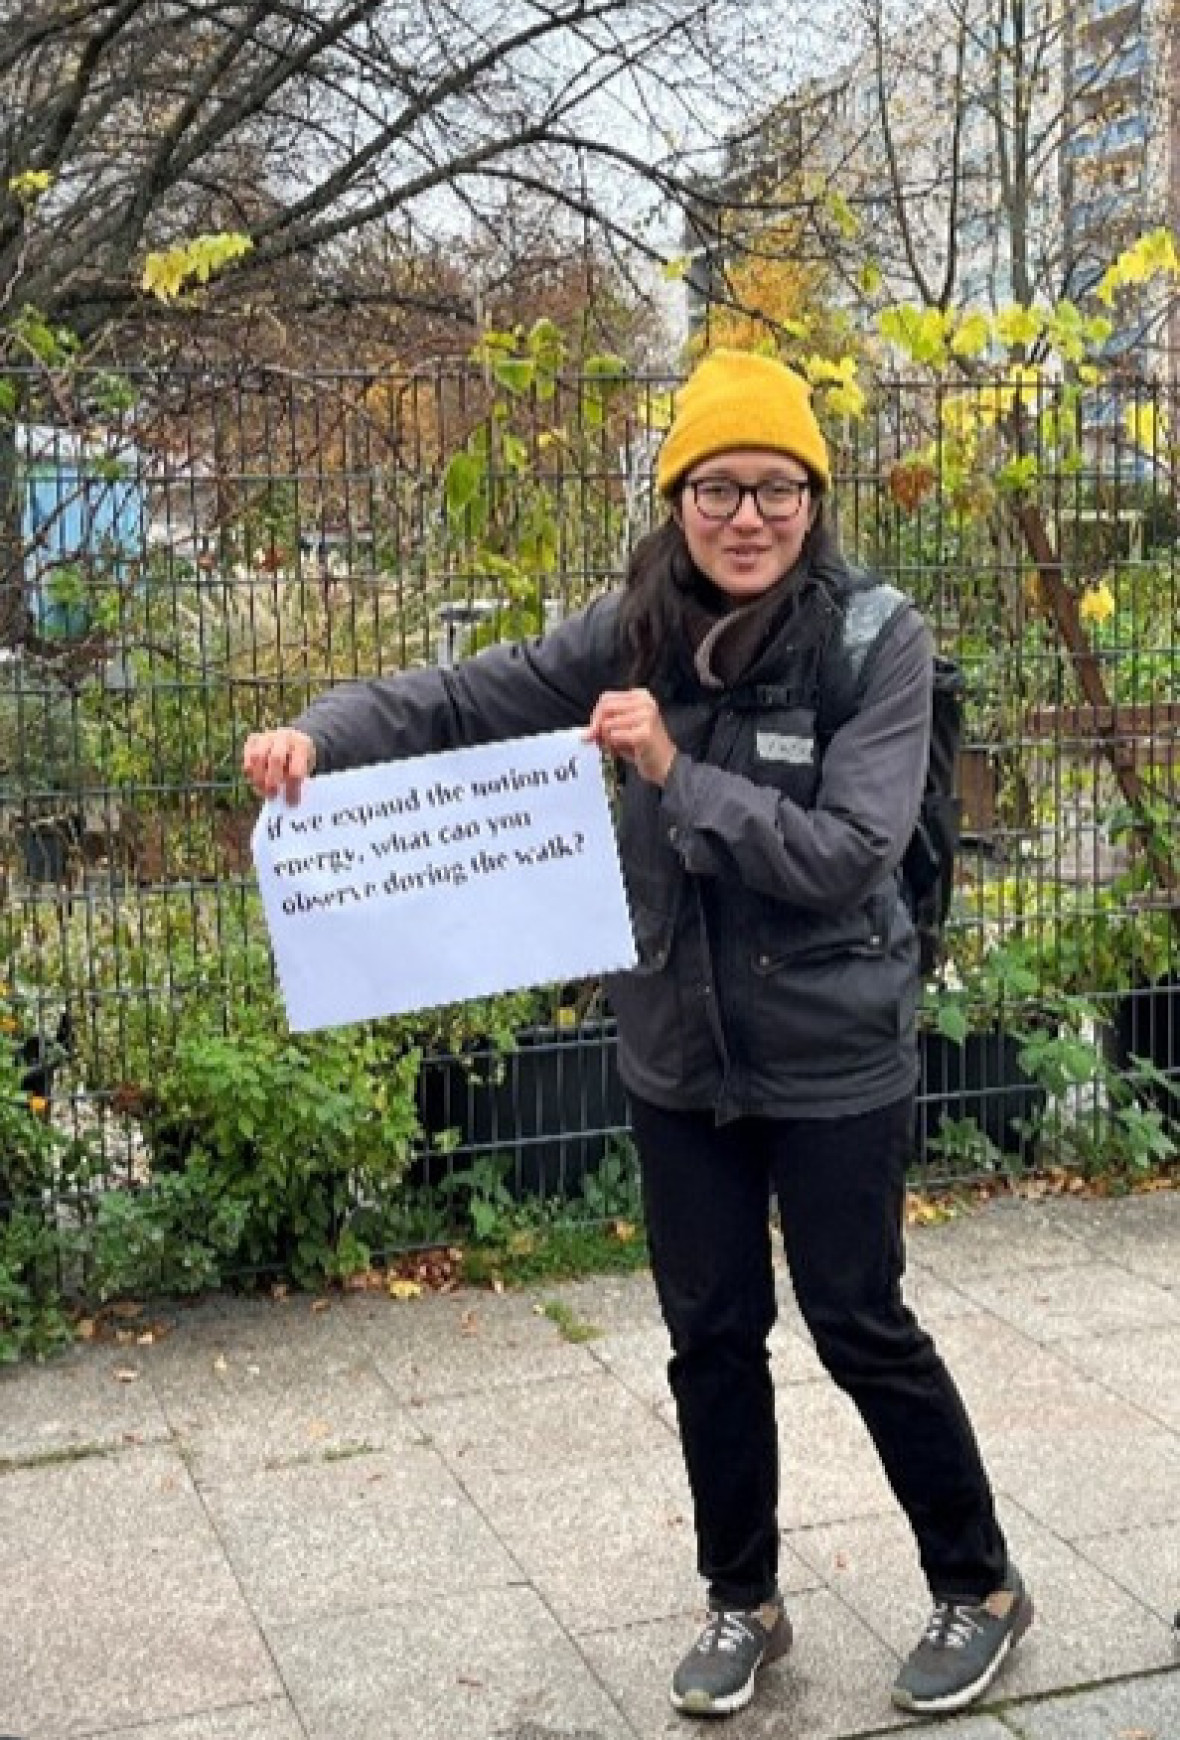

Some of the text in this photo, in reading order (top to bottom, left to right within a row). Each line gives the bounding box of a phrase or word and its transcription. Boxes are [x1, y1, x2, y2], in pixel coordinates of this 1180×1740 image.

[289, 814, 323, 834] we
[331, 787, 420, 827] expand
[426, 782, 465, 807] the
[470, 768, 549, 797] notion
[554, 756, 578, 783] of
[273, 810, 532, 877] energy, what can you
[282, 832, 585, 915] observe during the walk?
